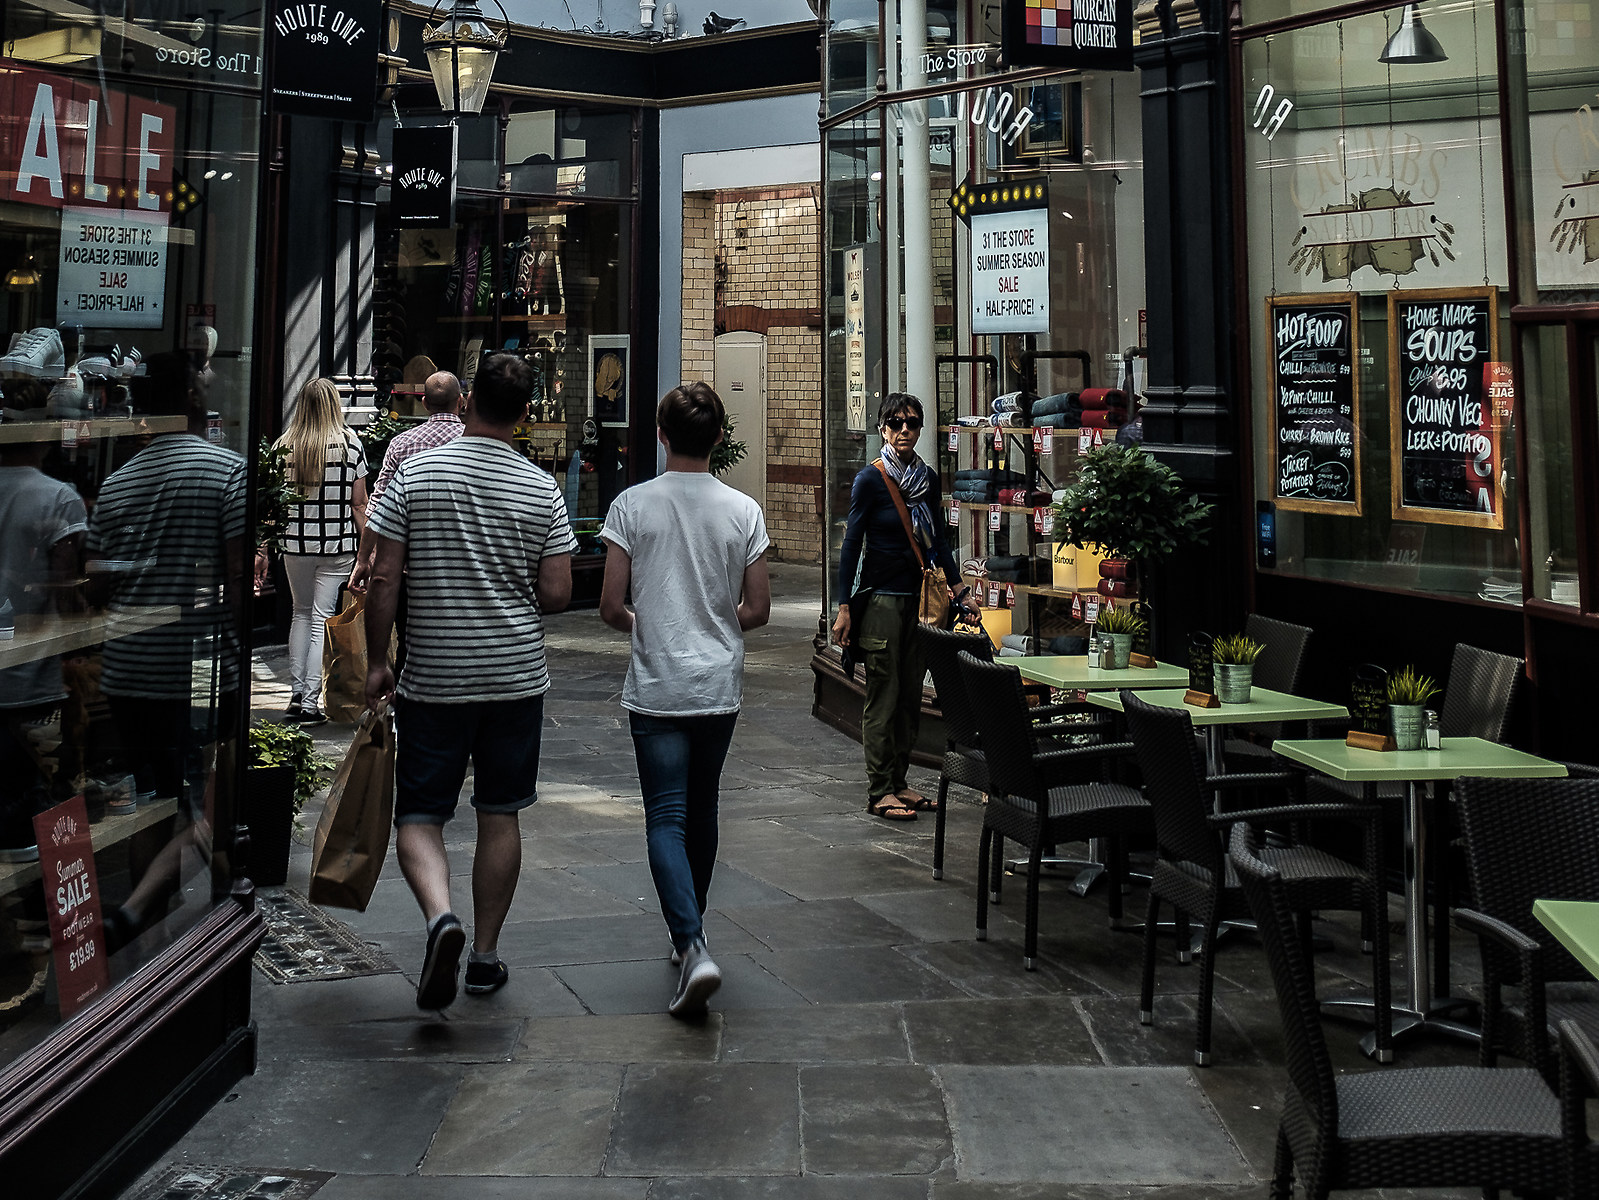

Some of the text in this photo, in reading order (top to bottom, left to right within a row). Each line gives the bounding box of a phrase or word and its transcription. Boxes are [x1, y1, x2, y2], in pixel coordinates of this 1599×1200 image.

[275, 3, 365, 46] ROUTE ONE
[1073, 22, 1117, 50] QUARTER
[305, 31, 329, 45] 1989
[918, 54, 943, 75] The
[947, 47, 986, 69] Store
[992, 231, 1008, 248] THE
[1009, 228, 1035, 247] STORE
[977, 251, 1045, 271] SUMMER SEASON
[998, 275, 1019, 293] SALE
[985, 299, 1035, 317] HALF-PRICE!
[1277, 313, 1343, 348] HOT FOOD
[1407, 328, 1477, 362] SOUPS
[1407, 395, 1456, 427] CHUNKY
[1407, 429, 1435, 450] LEEK
[1281, 455, 1309, 478] JACKET
[1280, 474, 1314, 492] POTATOES
[1053, 554, 1075, 566] Barbour
[57, 872, 92, 916] SALE
[62, 912, 94, 940] FOOTWEAR
[69, 939, 96, 972] £19.99
